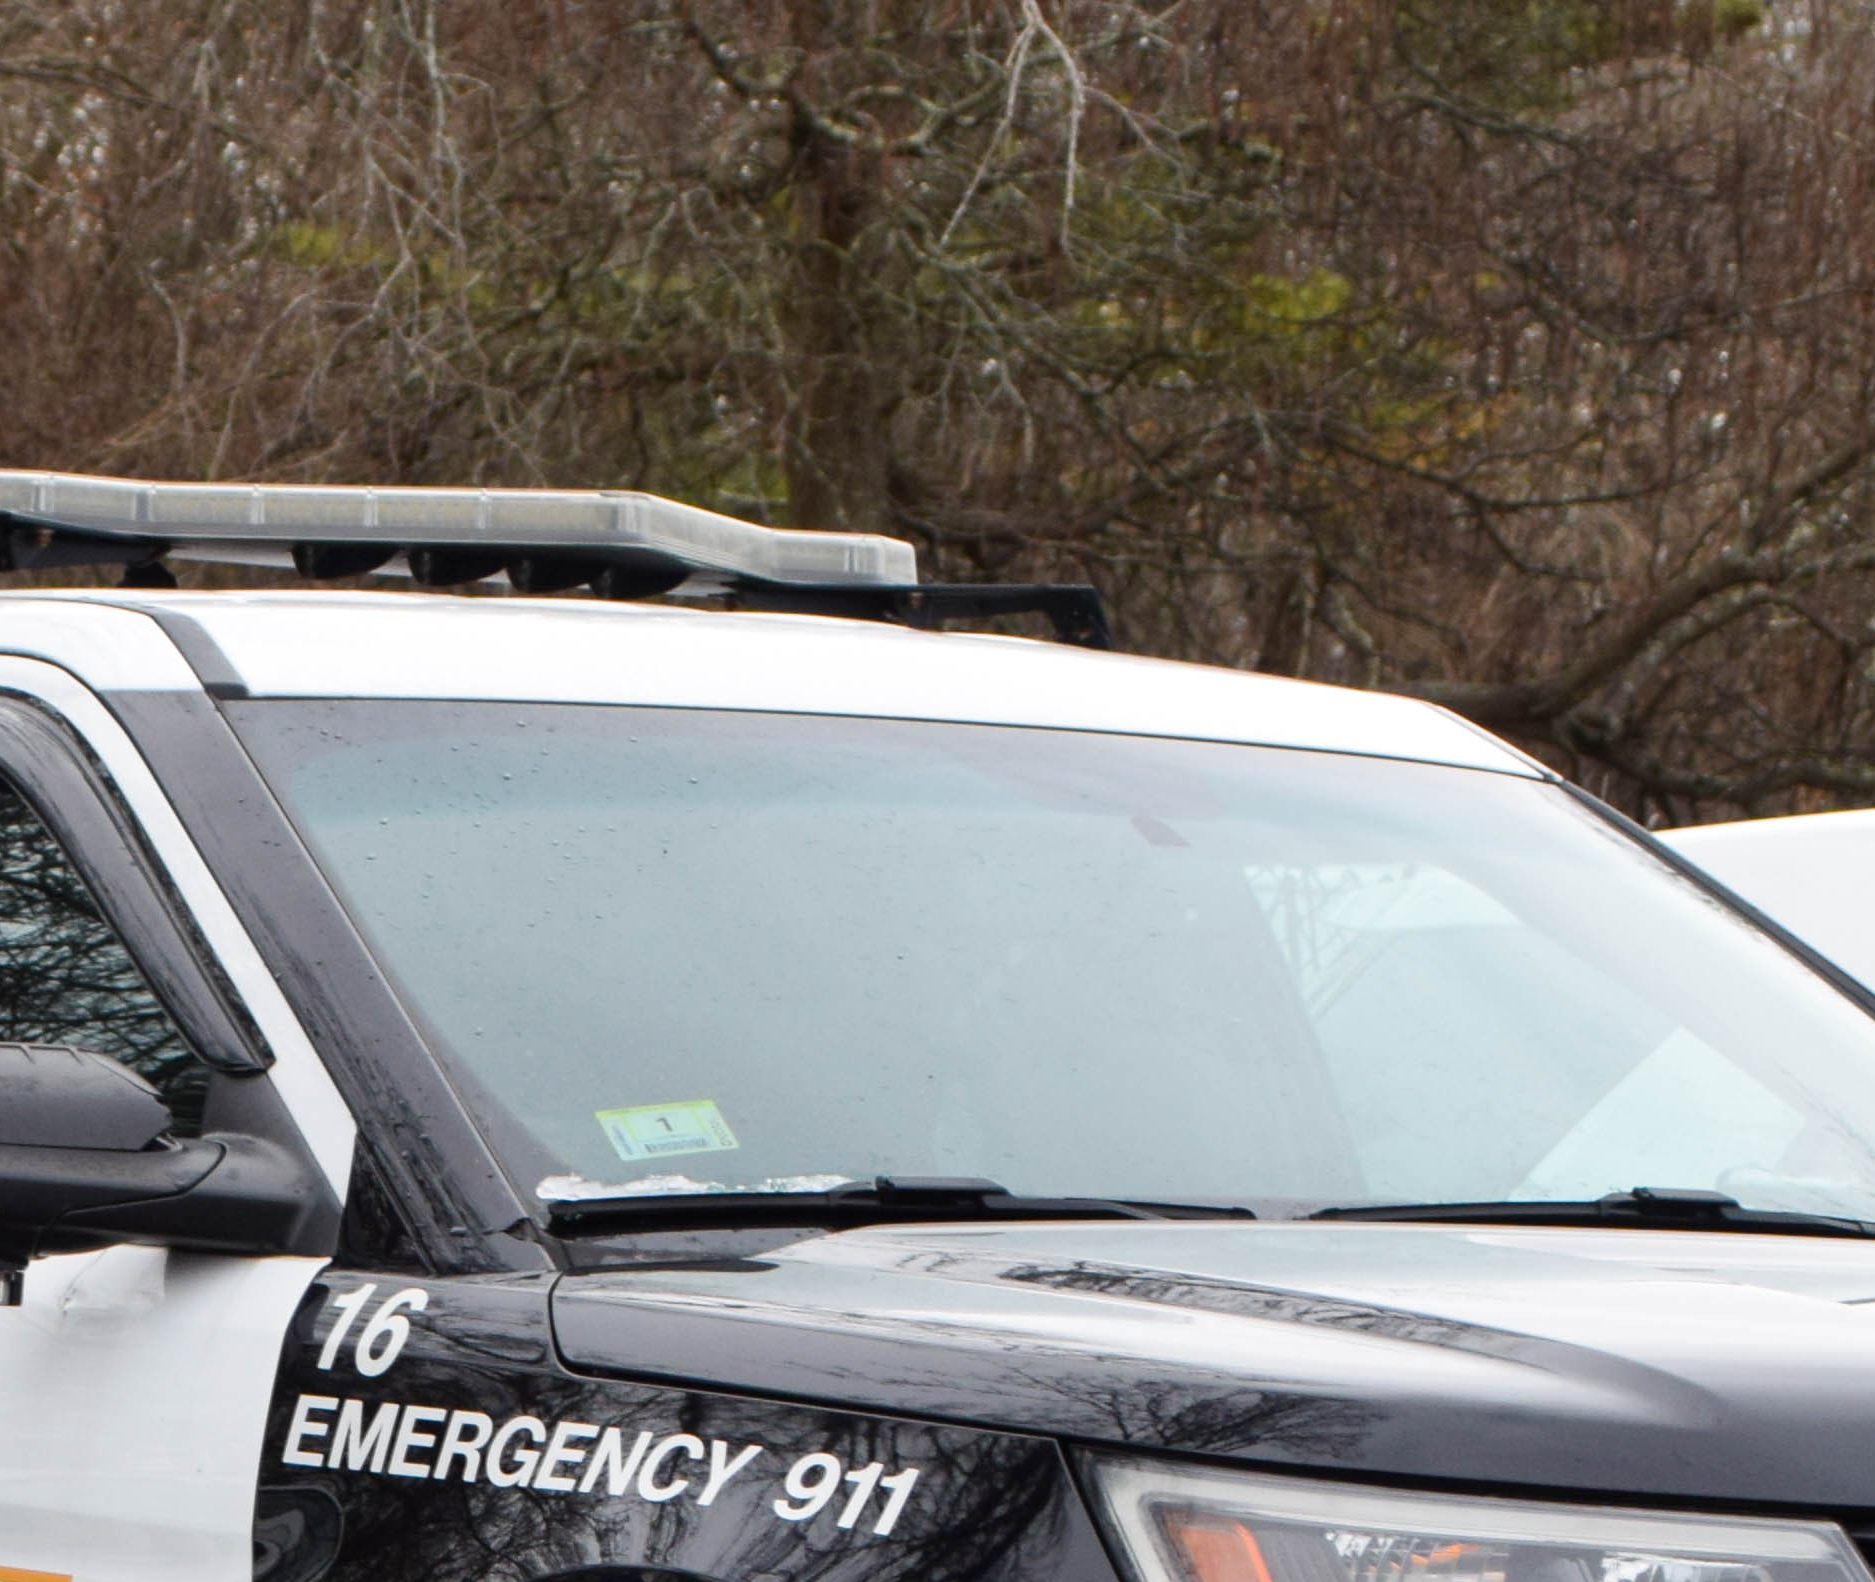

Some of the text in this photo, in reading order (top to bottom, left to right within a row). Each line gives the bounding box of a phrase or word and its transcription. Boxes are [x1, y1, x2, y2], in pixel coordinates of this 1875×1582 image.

[317, 1282, 429, 1377] 16
[282, 1393, 920, 1537] EMERGENCY 911
